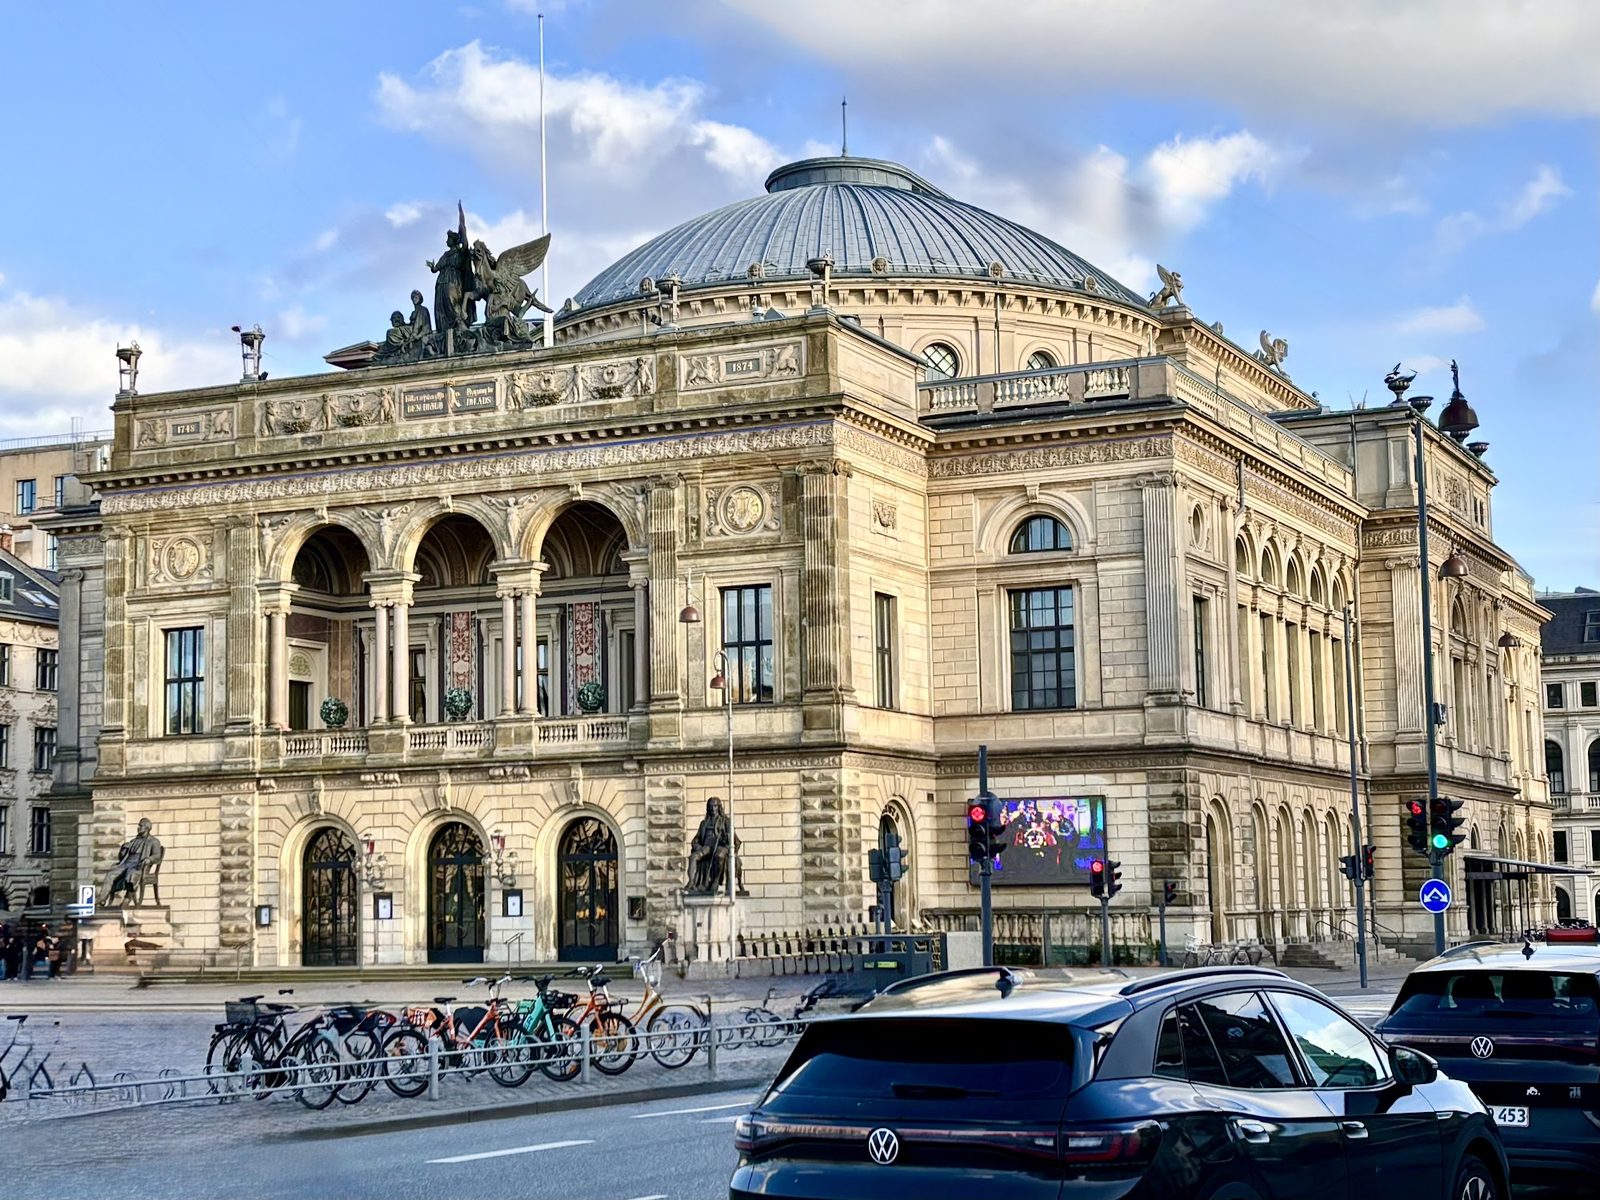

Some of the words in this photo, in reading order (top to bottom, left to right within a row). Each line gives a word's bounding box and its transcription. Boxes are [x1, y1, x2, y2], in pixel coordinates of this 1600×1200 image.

[732, 361, 754, 372] 1874
[177, 424, 196, 434] 1748
[83, 887, 93, 904] P
[1471, 1036, 1493, 1058] VW
[1498, 1108, 1526, 1123] 453
[868, 1127, 899, 1164] VW
